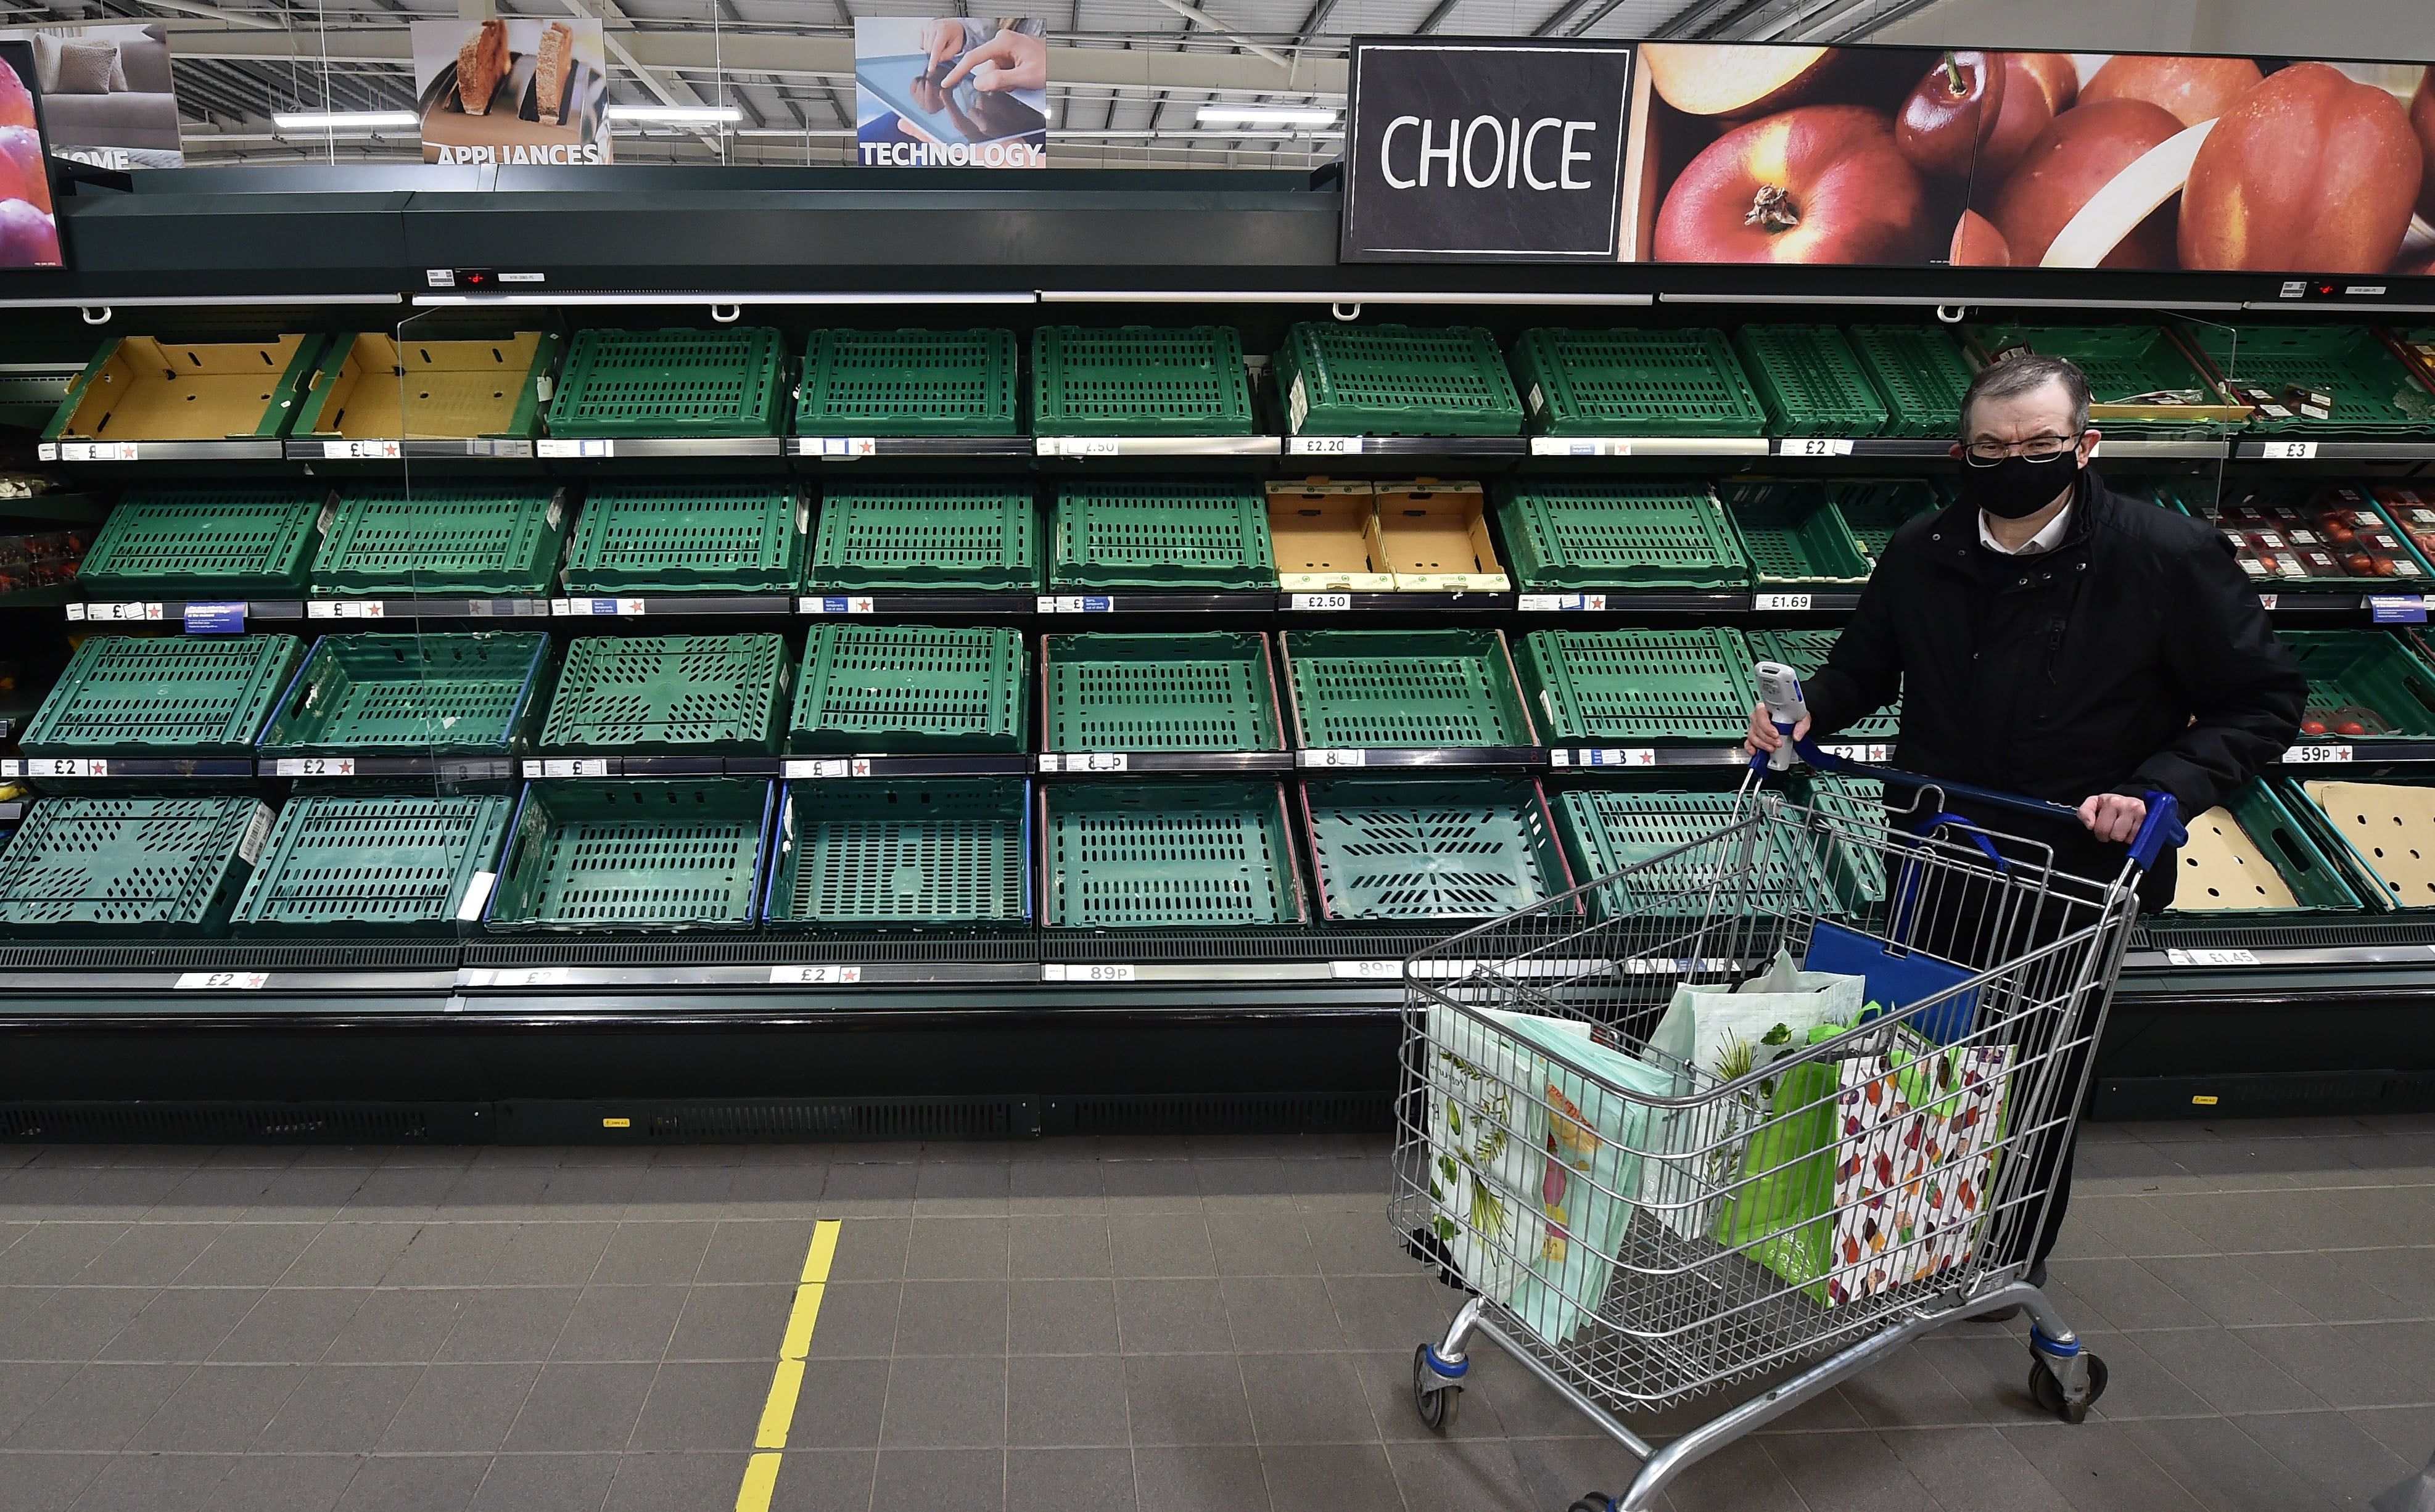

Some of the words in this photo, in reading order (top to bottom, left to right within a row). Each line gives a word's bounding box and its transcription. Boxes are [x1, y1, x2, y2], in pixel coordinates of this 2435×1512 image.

[437, 144, 599, 165] APPLIANCES
[859, 142, 1044, 166] TECHNOLOGY
[1381, 115, 1596, 190] CHOICE
[51, 151, 130, 170] OME
[1307, 441, 1343, 451] £2.20
[1805, 441, 1825, 454] £2
[2286, 443, 2305, 457] £3
[1309, 597, 1345, 607] £2.50
[1771, 596, 1808, 607] £1.69
[1834, 746, 1854, 760] £2
[2301, 747, 2330, 762] 59p
[54, 760, 76, 774] £2
[303, 759, 325, 774] £2
[1088, 755, 1121, 770] 8p
[2209, 952, 2253, 963] £1.45
[801, 969, 825, 981] £2
[1090, 967, 1127, 979] 89p
[1359, 962, 1395, 976] 89p
[205, 974, 234, 986] £2
[525, 972, 551, 984] £2
